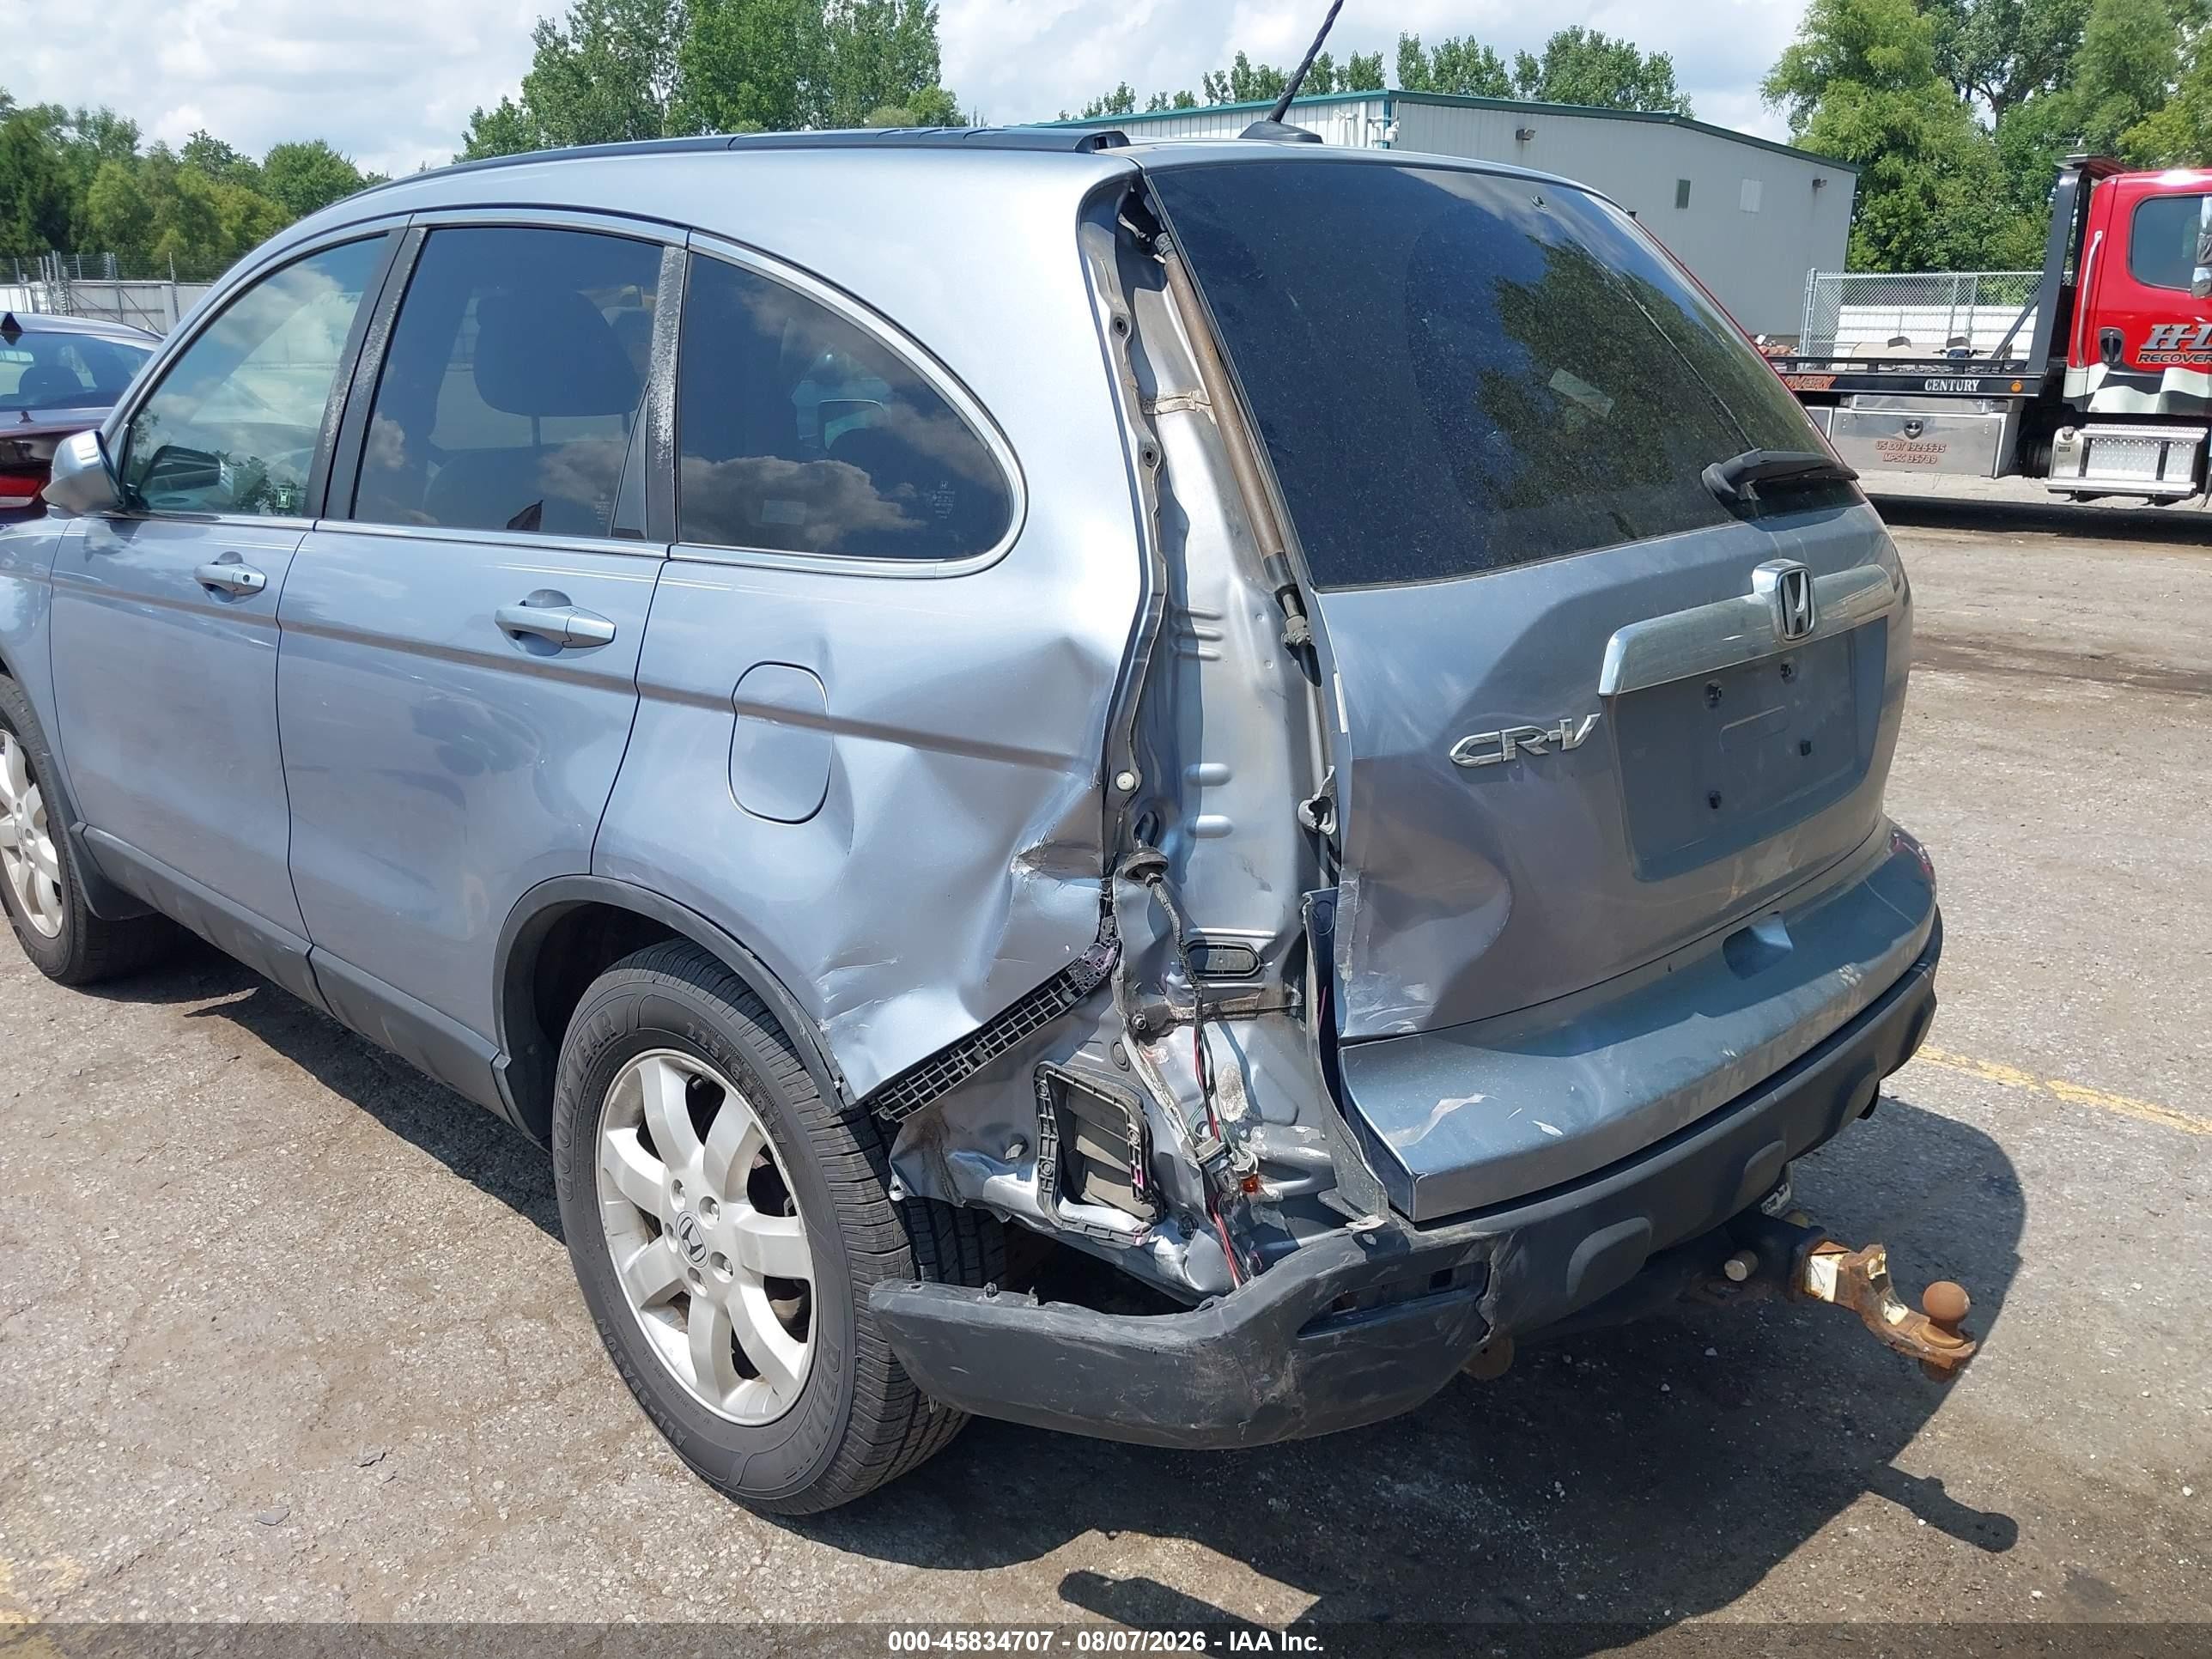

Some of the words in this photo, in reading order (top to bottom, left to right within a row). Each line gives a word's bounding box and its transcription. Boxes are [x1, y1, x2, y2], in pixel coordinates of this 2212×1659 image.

[1924, 379, 1980, 392] CENTURY
[1875, 441, 1888, 451] US
[1889, 441, 1905, 452] DOT
[1883, 453, 1906, 463] MPSC
[1449, 713, 1601, 767] CR-V
